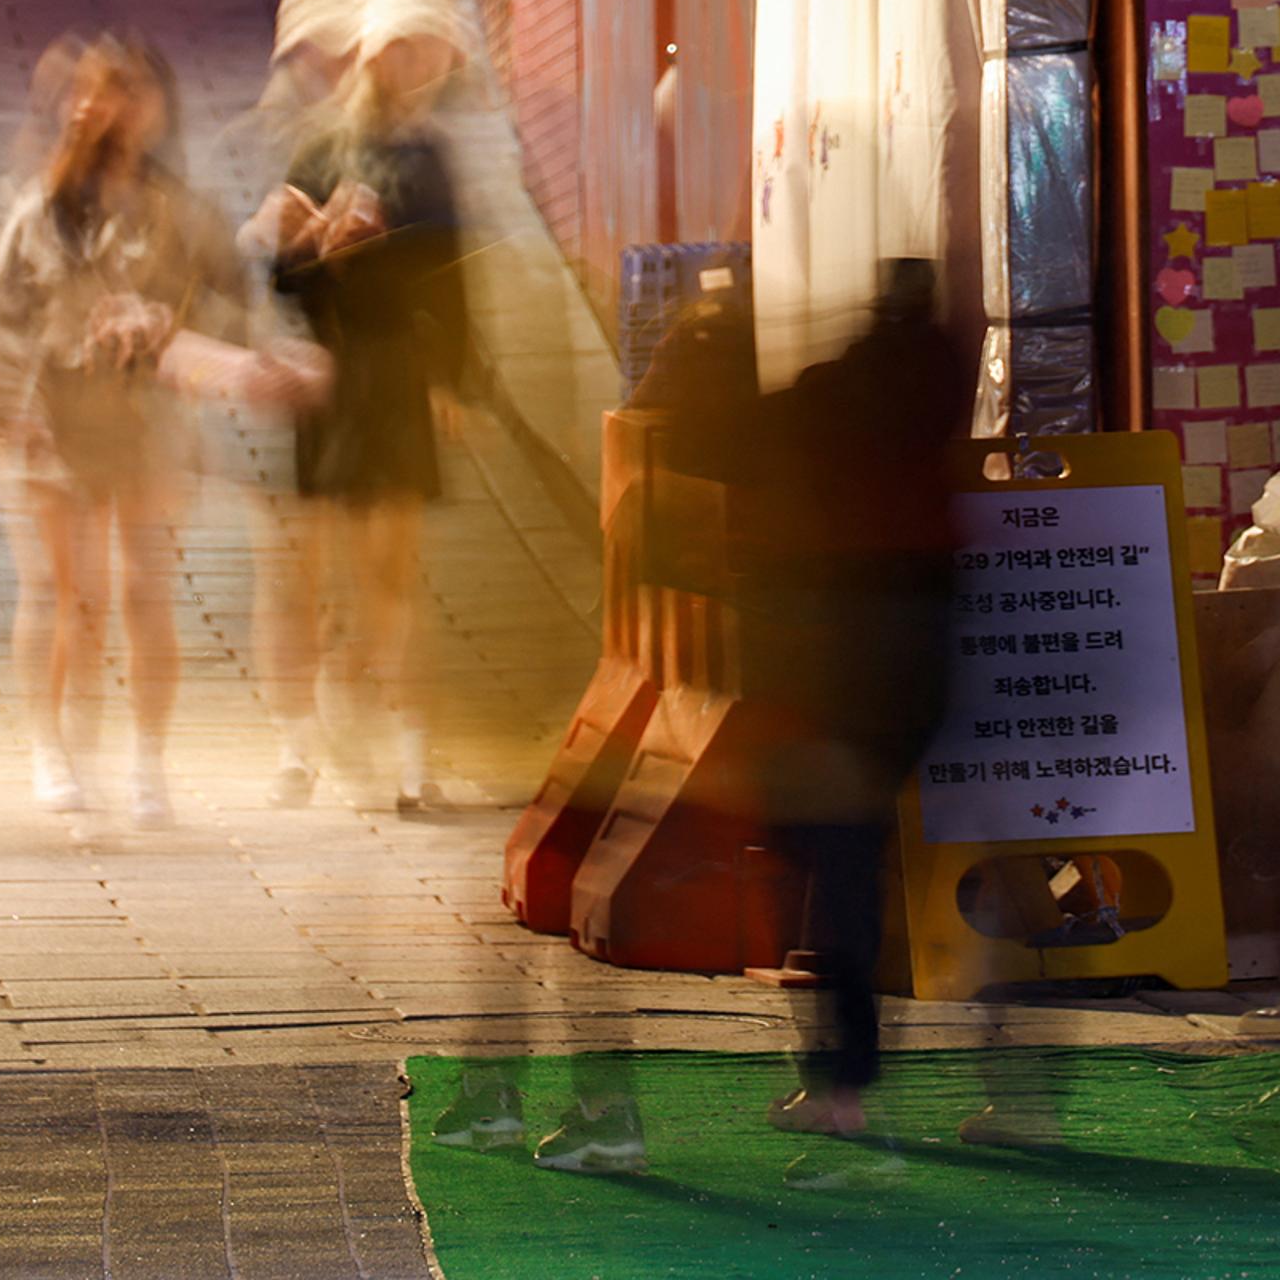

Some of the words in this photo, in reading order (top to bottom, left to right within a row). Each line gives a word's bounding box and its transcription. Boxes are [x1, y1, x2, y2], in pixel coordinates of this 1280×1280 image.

[1002, 506, 1060, 528] 지금은
[995, 550, 1051, 571] 기억과
[1057, 547, 1114, 568] 안전의
[956, 594, 992, 614] 조성
[999, 588, 1121, 612] 공사중입니다.
[959, 634, 1017, 656] 통행에
[1022, 632, 1079, 653] 불편을
[1085, 629, 1123, 650] 드려
[994, 673, 1097, 697] 죄송합니다.
[974, 719, 1011, 739] 보다
[1017, 717, 1074, 737] 안전한
[1081, 714, 1118, 735] 길을
[928, 762, 986, 785] 만들기
[992, 759, 1031, 780] 위해
[1035, 754, 1177, 779] 노력하겠습니다.
